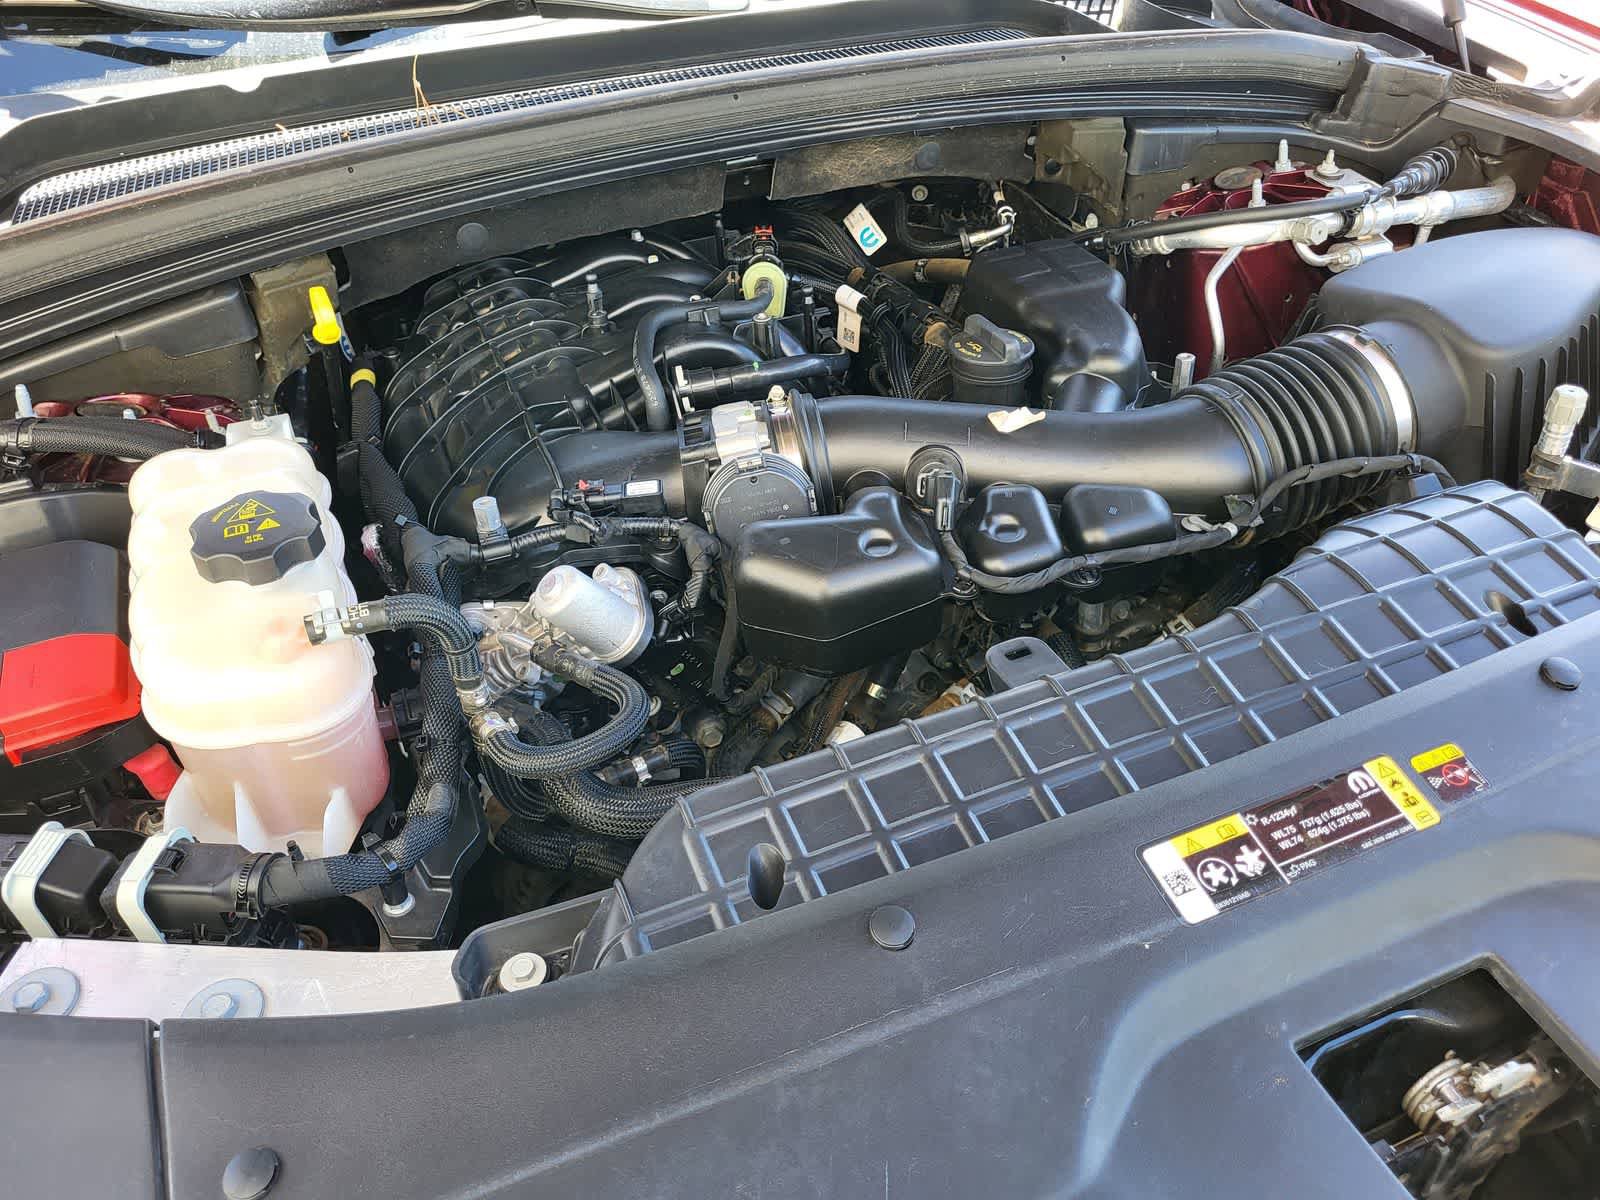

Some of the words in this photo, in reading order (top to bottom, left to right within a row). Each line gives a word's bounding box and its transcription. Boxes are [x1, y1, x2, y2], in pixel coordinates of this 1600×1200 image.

[1271, 825, 1297, 840] WL75
[1299, 817, 1321, 830] 737g
[1279, 835, 1304, 850] WL74
